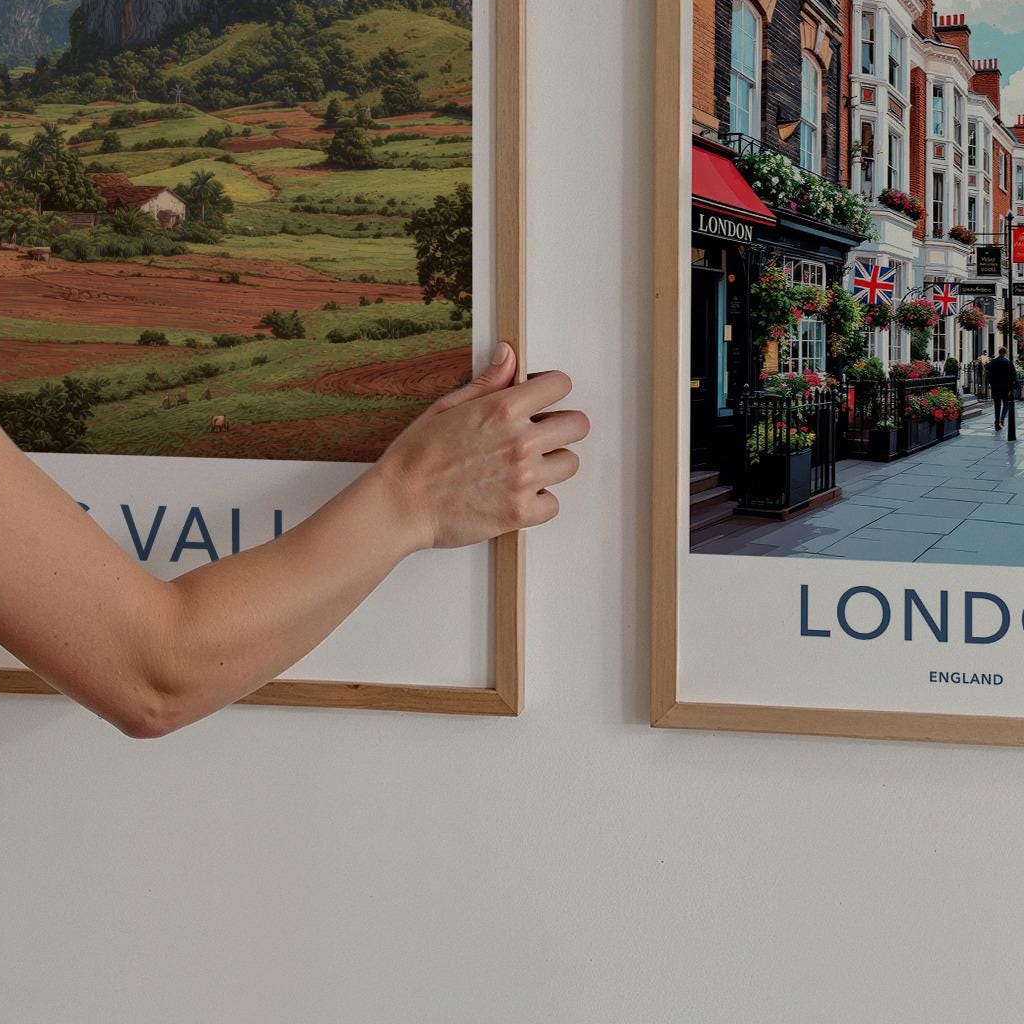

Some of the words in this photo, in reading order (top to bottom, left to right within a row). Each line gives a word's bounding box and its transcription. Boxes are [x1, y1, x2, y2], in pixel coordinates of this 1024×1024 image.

[698, 213, 753, 242] LONDON
[800, 584, 1024, 645] LOND
[929, 671, 1004, 686] ENGLAND
